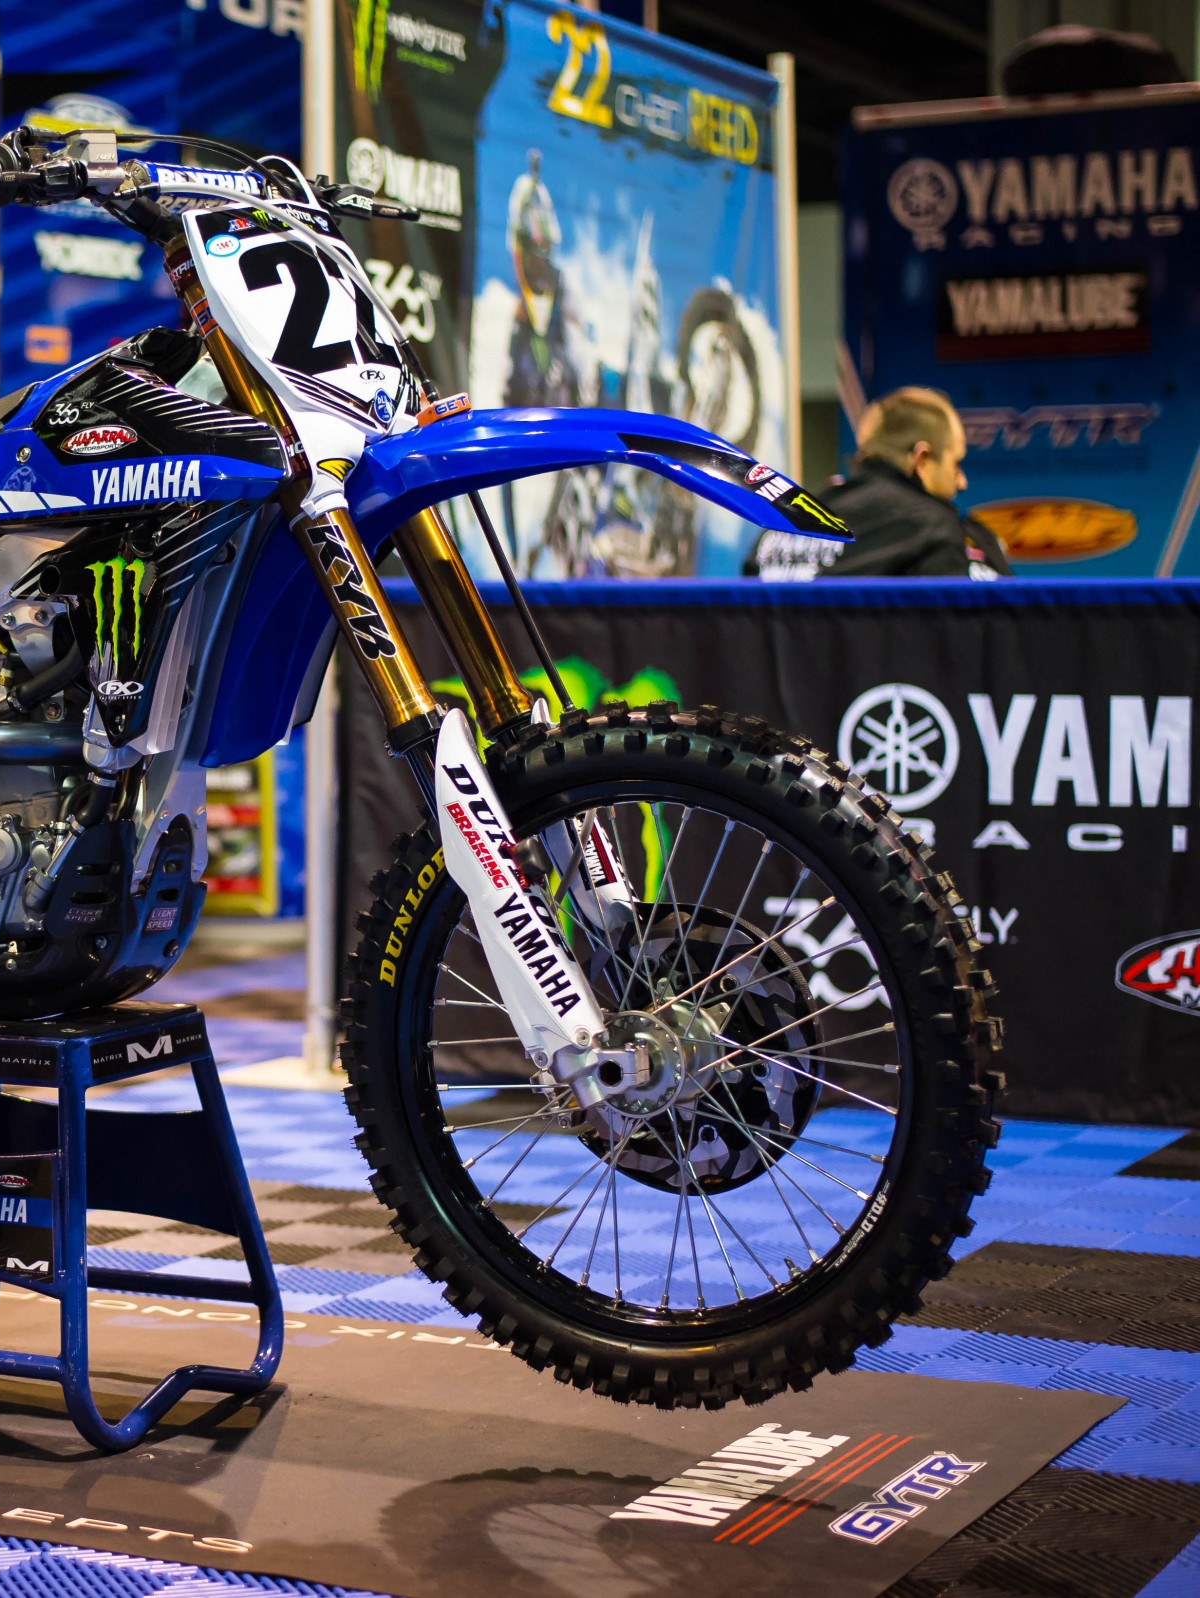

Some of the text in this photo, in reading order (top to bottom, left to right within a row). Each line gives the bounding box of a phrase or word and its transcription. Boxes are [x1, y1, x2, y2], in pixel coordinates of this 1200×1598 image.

[546, 11, 612, 128] 22
[958, 147, 1199, 222] YAMAHA
[946, 271, 1146, 336] YAMALUBE
[49, 402, 79, 425] 360
[434, 395, 467, 416] GET
[61, 429, 138, 450] CHAPARRAL
[92, 460, 201, 505] YAMAHA
[307, 524, 397, 661] KYB
[967, 692, 1196, 807] YAM
[446, 802, 510, 889] BRAKING
[147, 920, 173, 929] SPEED
[152, 909, 178, 919] LIGHT
[493, 892, 582, 1018] YAMAHA
[1122, 948, 1200, 992] CH
[1, 1056, 51, 1066] MATRIX
[93, 1053, 123, 1064] MATRIX
[175, 1034, 202, 1044] MATRIX
[608, 1424, 851, 1526] YAMALUBE
[828, 1451, 988, 1546] GYTR
